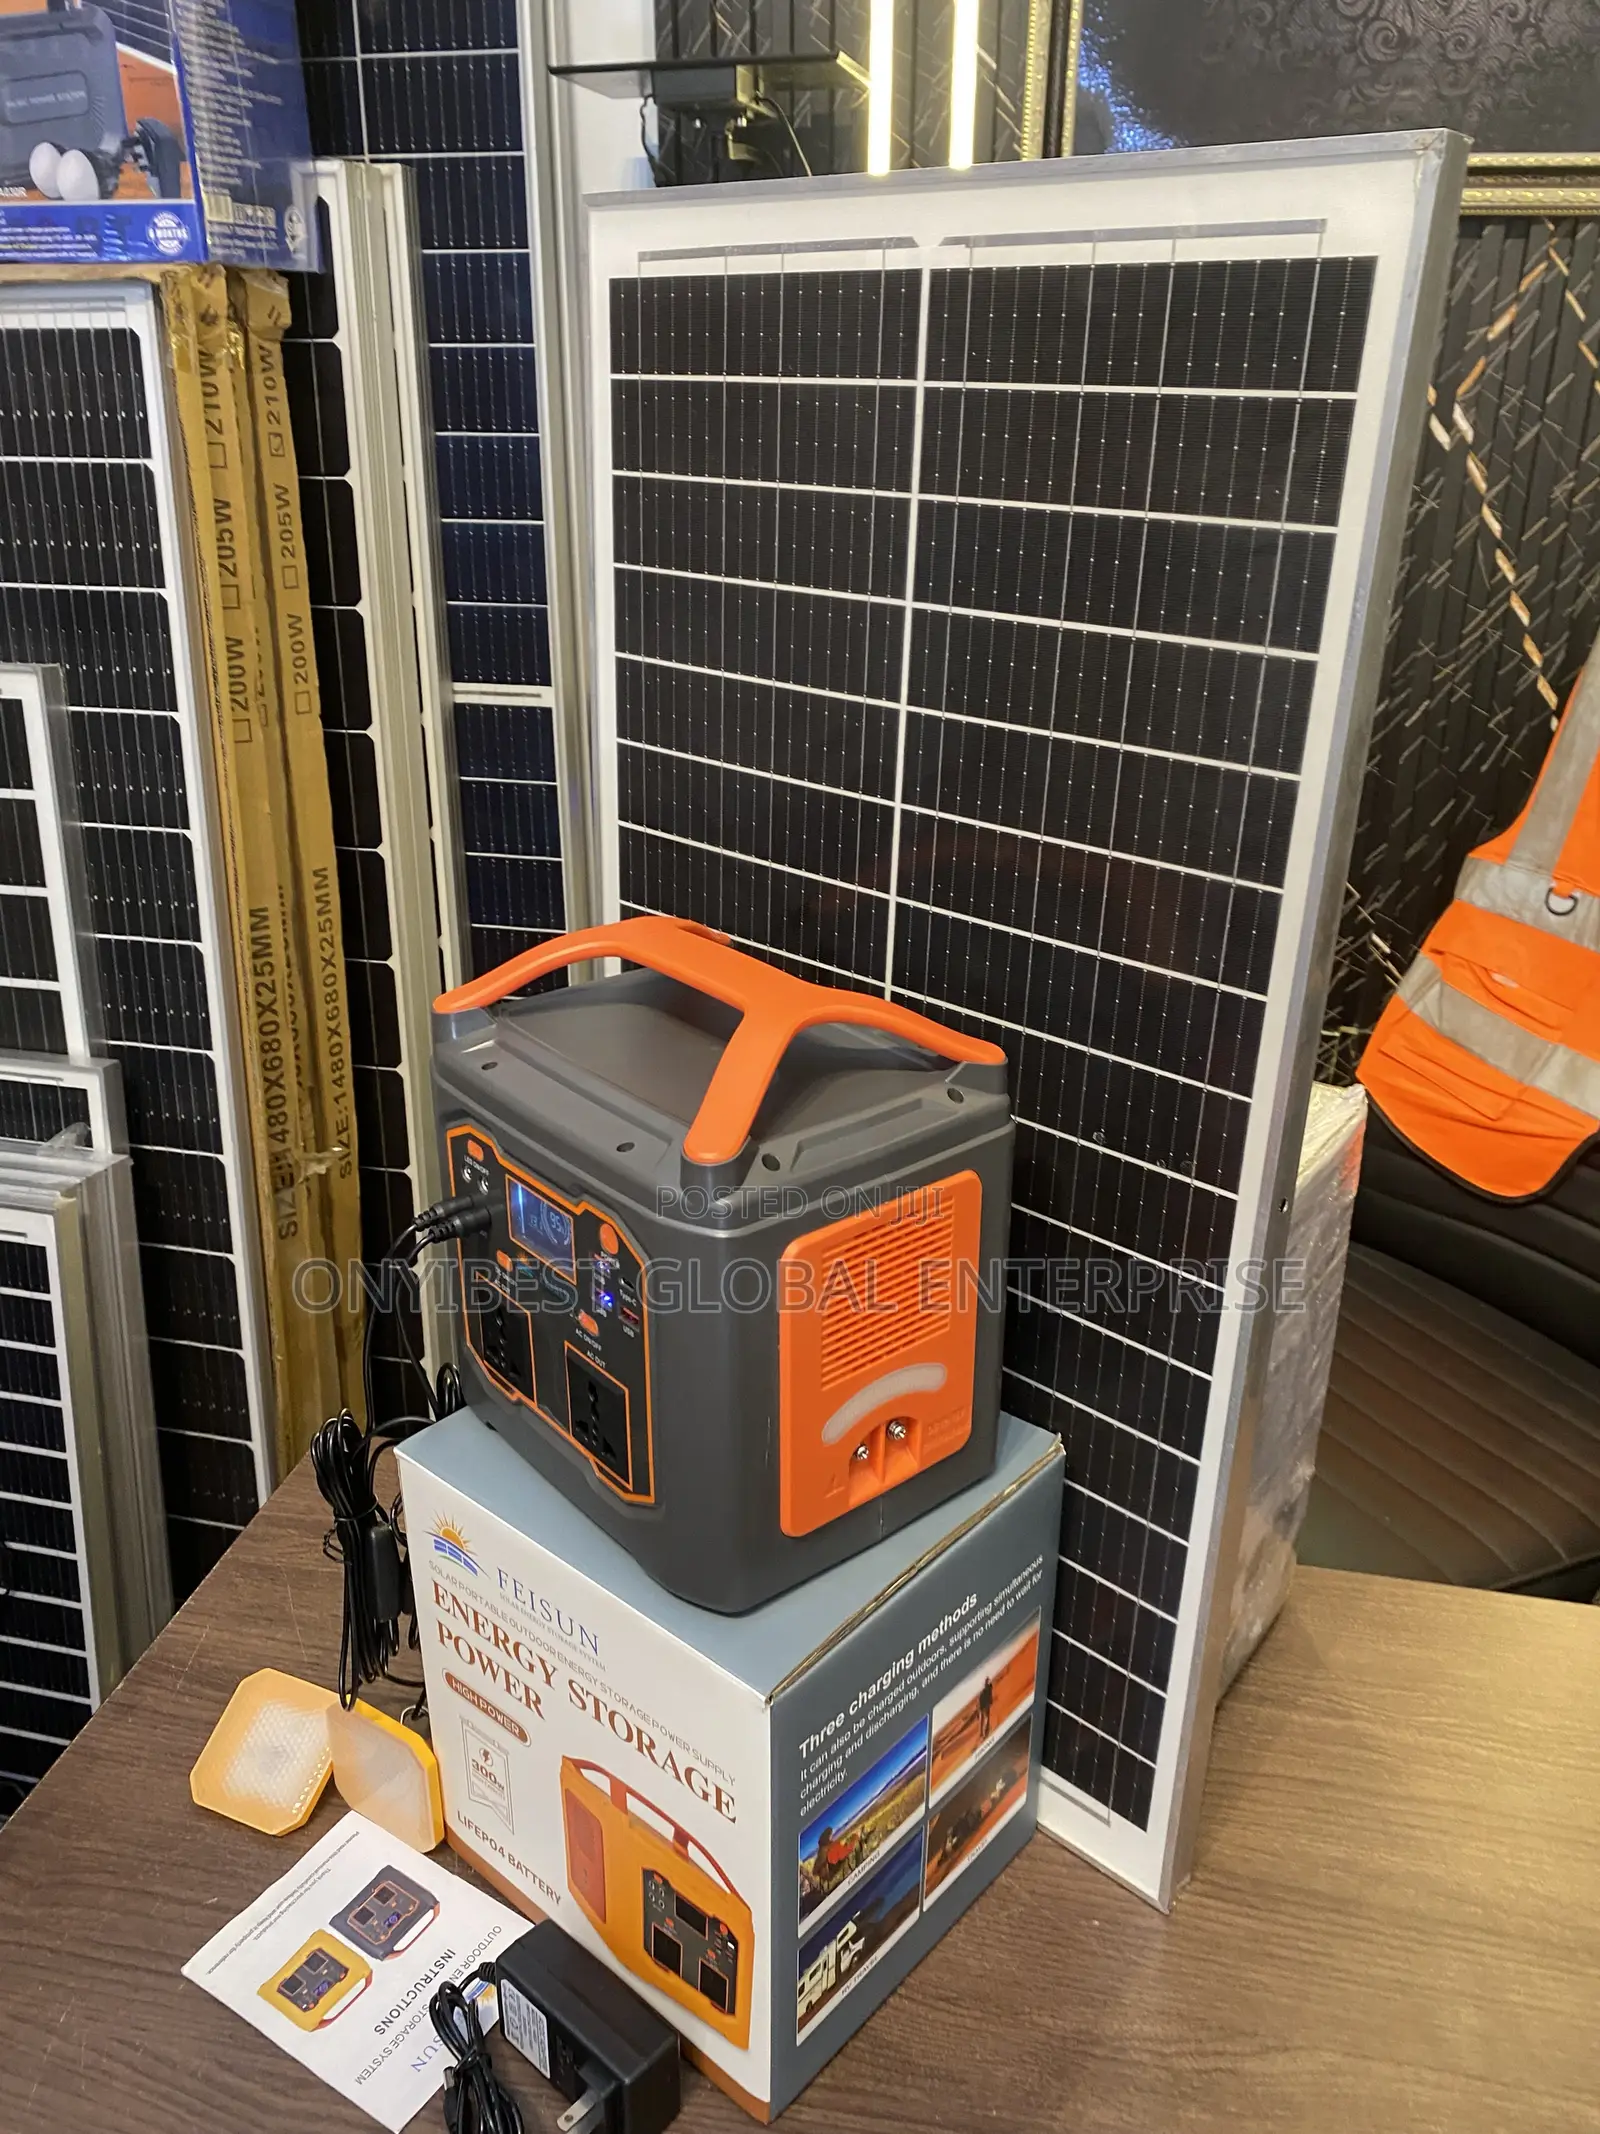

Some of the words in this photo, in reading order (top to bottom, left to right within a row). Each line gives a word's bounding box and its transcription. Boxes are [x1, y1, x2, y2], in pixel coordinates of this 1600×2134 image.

[258, 343, 282, 426] 210W
[213, 497, 240, 577] 205W
[277, 484, 296, 559] 205W
[225, 636, 250, 711] 200W
[287, 612, 310, 685] 200W
[496, 1566, 600, 1657] FEISUN
[428, 1559, 458, 1589] SOLAR
[458, 1582, 509, 1625] PORTABLE
[508, 1617, 558, 1659] OUTDOOR
[557, 1652, 599, 1687] ENERGY
[600, 1681, 652, 1726] STORAGE
[651, 1718, 691, 1755] POWER
[692, 1748, 736, 1786] SUPPLY
[431, 1577, 559, 1691] ENERGY
[568, 1678, 737, 1824] STORAGE
[436, 1618, 546, 1721] POWER
[452, 1678, 479, 1706] HIGH
[479, 1697, 521, 1738] POWER
[799, 1713, 845, 1760] Three
[848, 1649, 915, 1717] charging
[918, 1592, 978, 1655] methods
[800, 1769, 808, 1782] It
[809, 1752, 828, 1774] can
[830, 1731, 851, 1758] also
[852, 1717, 866, 1733] be
[867, 1681, 905, 1721] charged
[906, 1646, 948, 1685] outdoors,
[949, 1601, 993, 1646] supporting
[993, 1554, 1043, 1605] simultaneous
[800, 1755, 843, 1800] charging
[845, 1736, 864, 1758] and
[865, 1685, 920, 1738] discharging,
[922, 1666, 939, 1688] and
[940, 1648, 962, 1674] there
[963, 1638, 972, 1653] is
[973, 1626, 984, 1642] no
[985, 1611, 1005, 1635] need
[1006, 1597, 1016, 1612] to
[1016, 1581, 1032, 1602] wait
[1032, 1569, 1043, 1583] for
[457, 1809, 506, 1858] LIFEPO4
[507, 1851, 562, 1906] BATTERY
[461, 1925, 503, 1971] OUTDOOR
[373, 1948, 457, 2036] INSTRUCTIONS
[389, 2003, 430, 2049] STORAGE
[355, 2044, 393, 2086] SYSTEM
